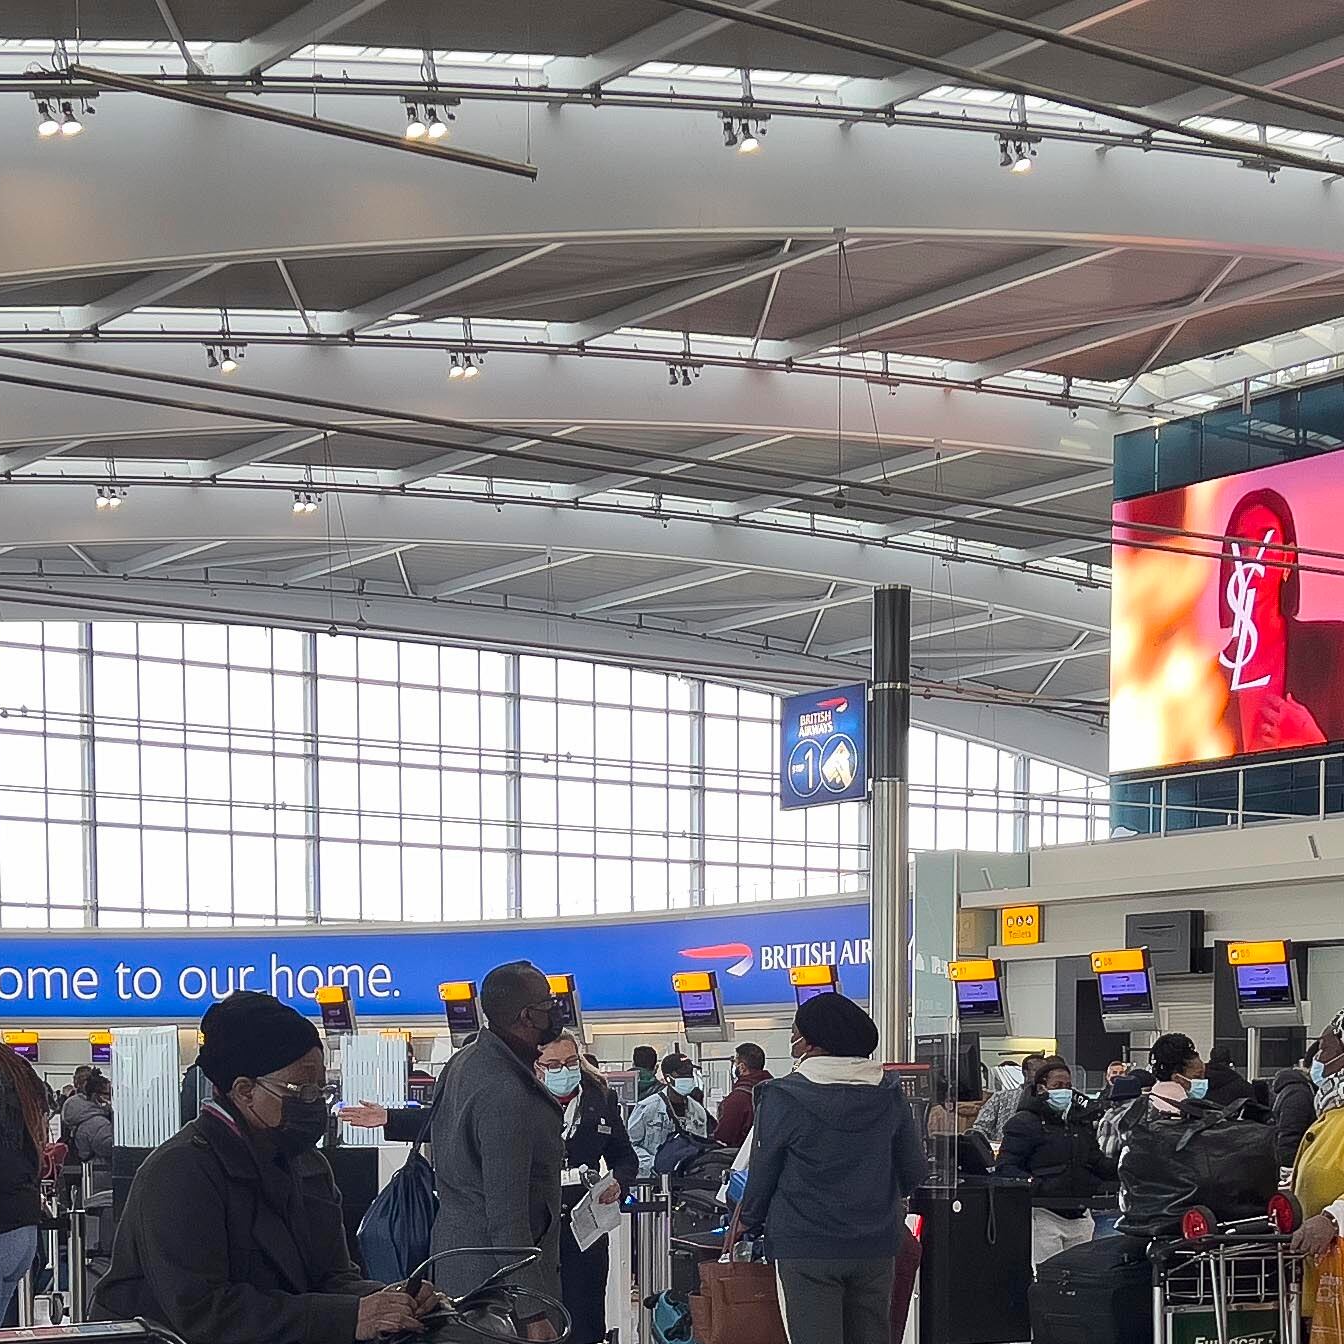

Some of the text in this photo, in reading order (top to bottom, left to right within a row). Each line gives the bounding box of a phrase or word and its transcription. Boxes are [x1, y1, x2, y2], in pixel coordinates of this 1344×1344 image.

[798, 721, 834, 738] AIRWAYS
[799, 710, 832, 726] BRITISH
[804, 748, 813, 789] 1
[1008, 930, 1031, 939] Toilets
[760, 938, 873, 970] BRITISH AIR
[114, 962, 162, 1000] to
[178, 965, 254, 1000] our
[271, 952, 400, 999] home.
